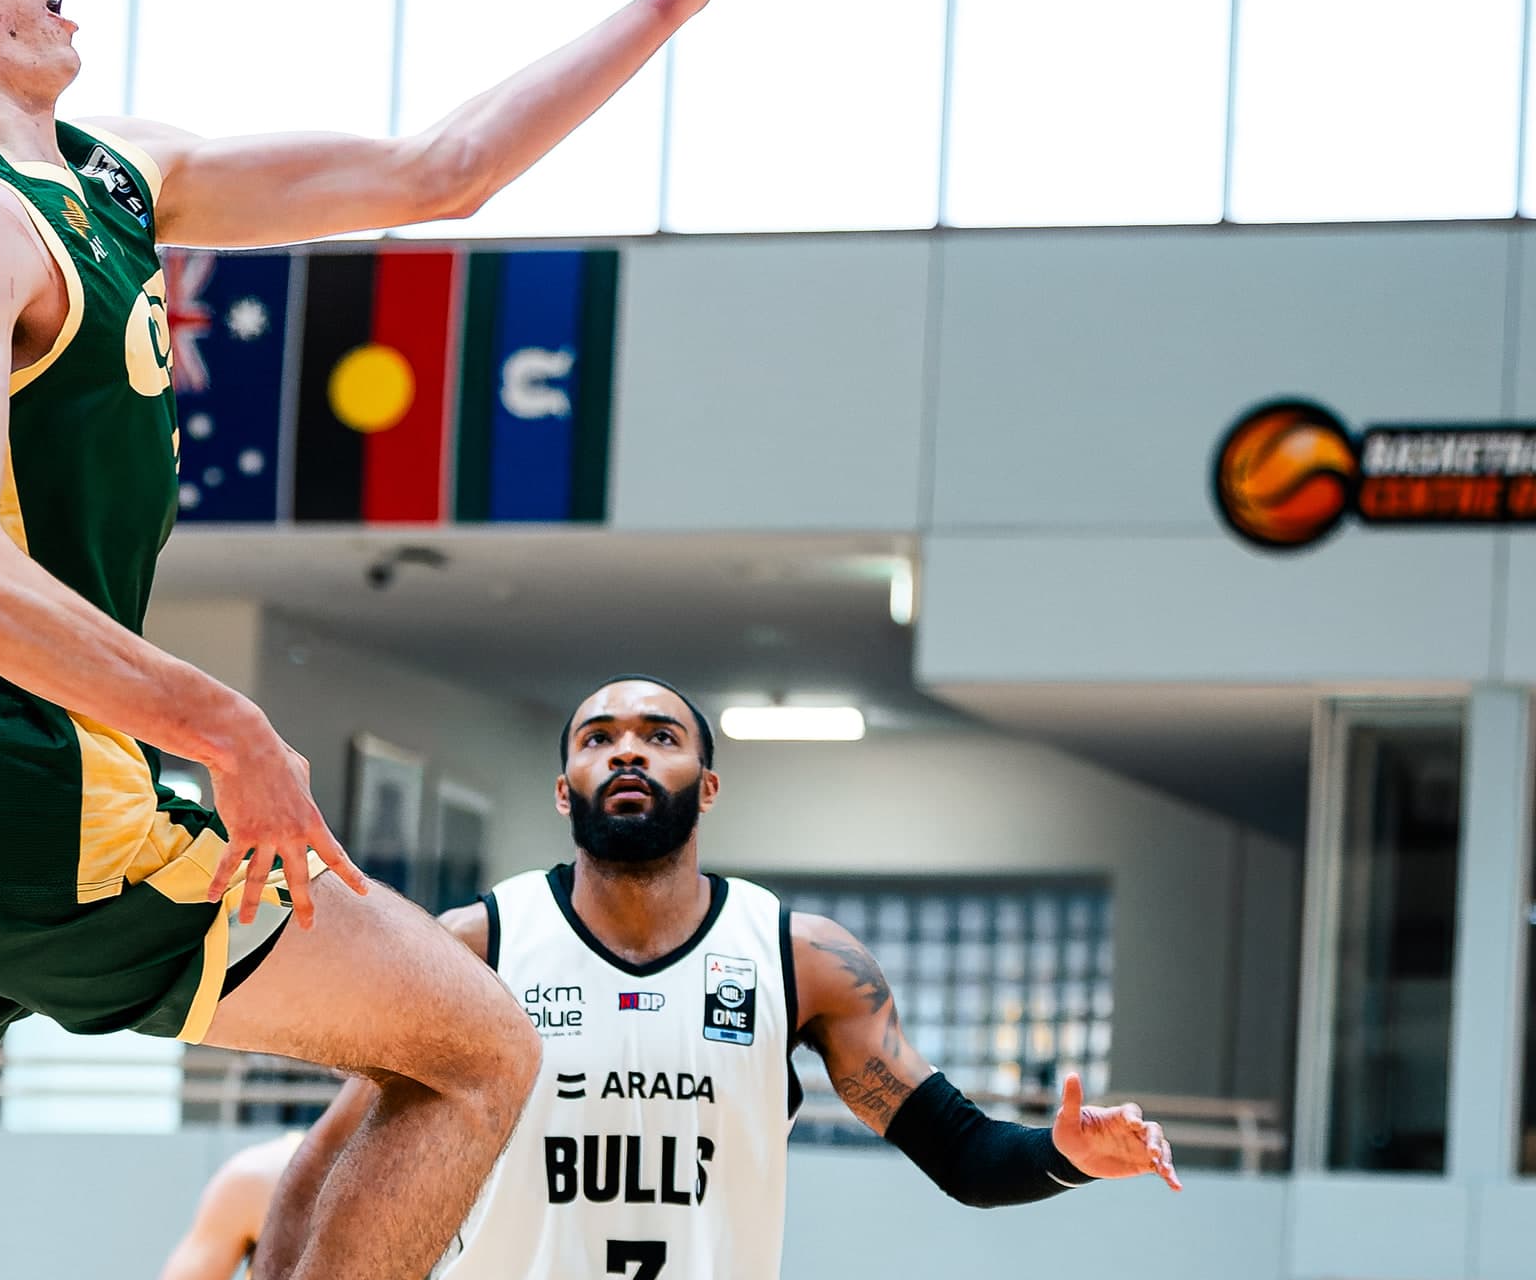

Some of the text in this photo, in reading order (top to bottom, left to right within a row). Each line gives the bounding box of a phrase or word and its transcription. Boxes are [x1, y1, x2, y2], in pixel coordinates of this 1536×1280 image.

[713, 1008, 747, 1029] ONE
[601, 1071, 715, 1103] ARADA
[544, 1134, 715, 1206] BULLS
